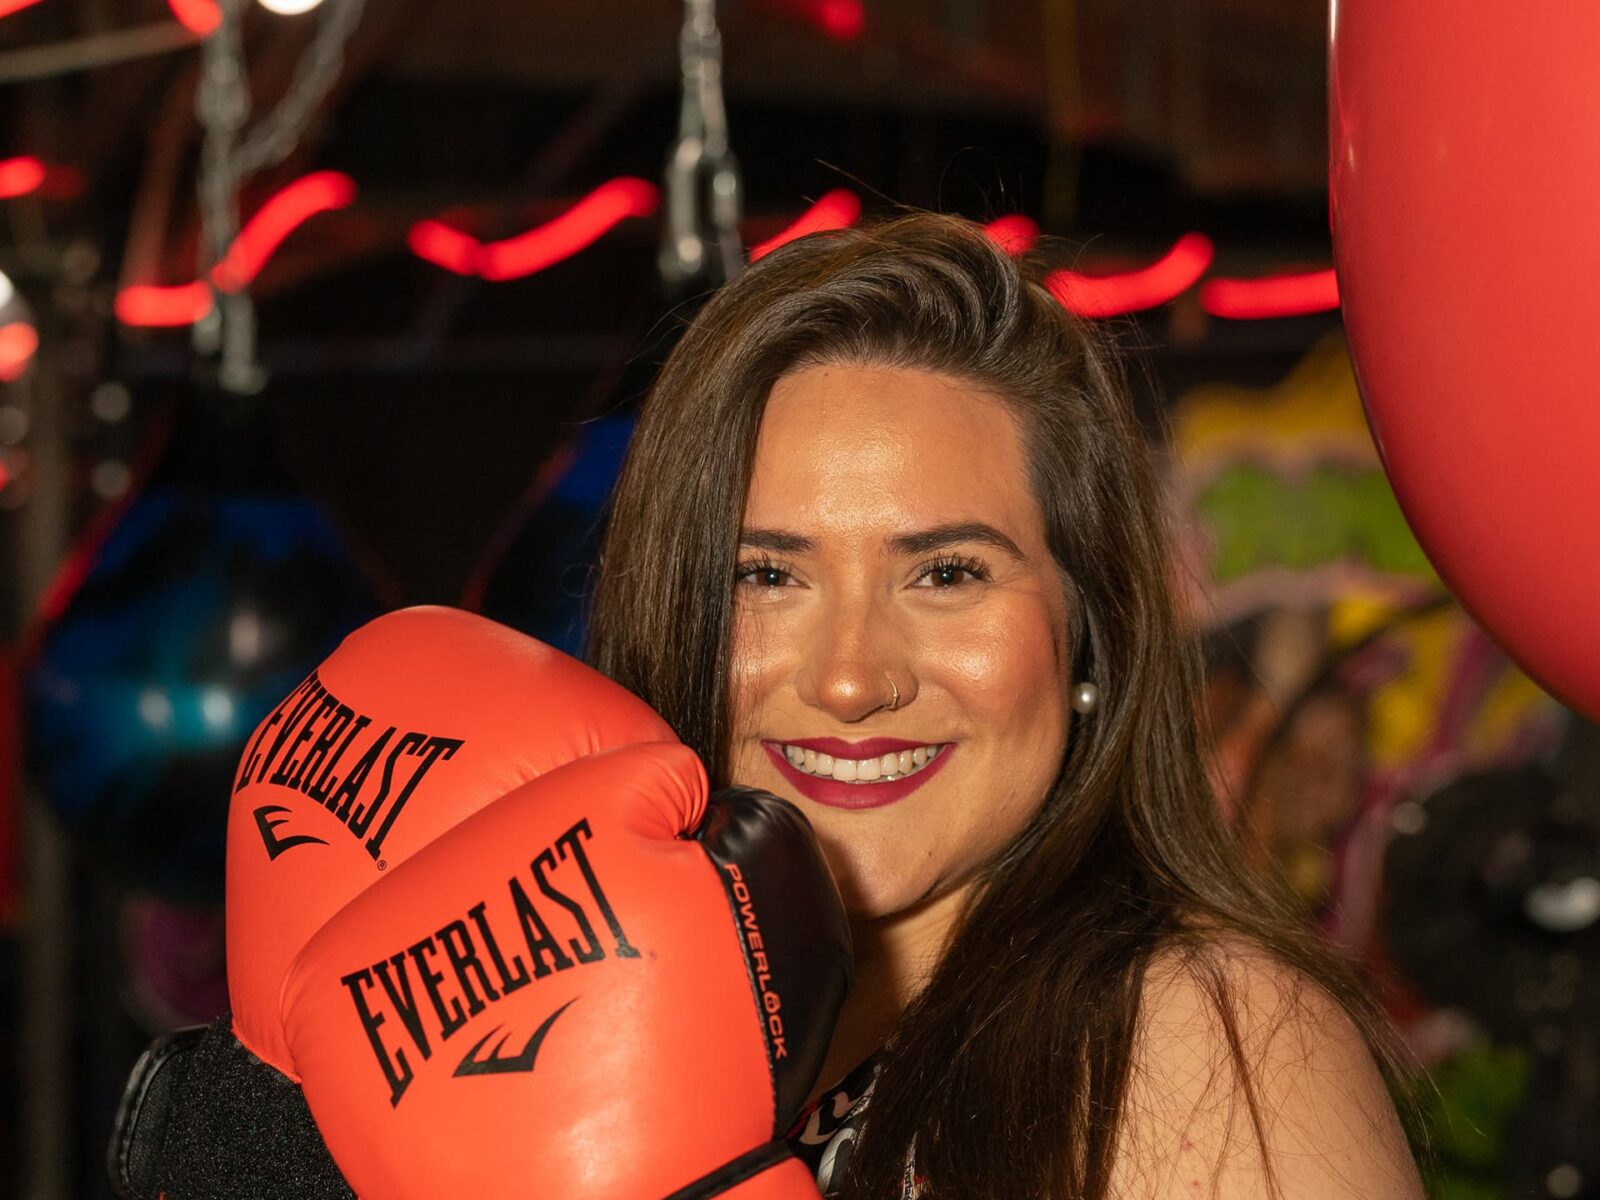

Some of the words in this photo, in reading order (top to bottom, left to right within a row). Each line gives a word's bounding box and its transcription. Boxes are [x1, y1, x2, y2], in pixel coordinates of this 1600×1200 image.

[235, 669, 466, 862] EVERLAST
[340, 817, 643, 1110] EVERLAST
[724, 863, 788, 1060] POWERLOCK
